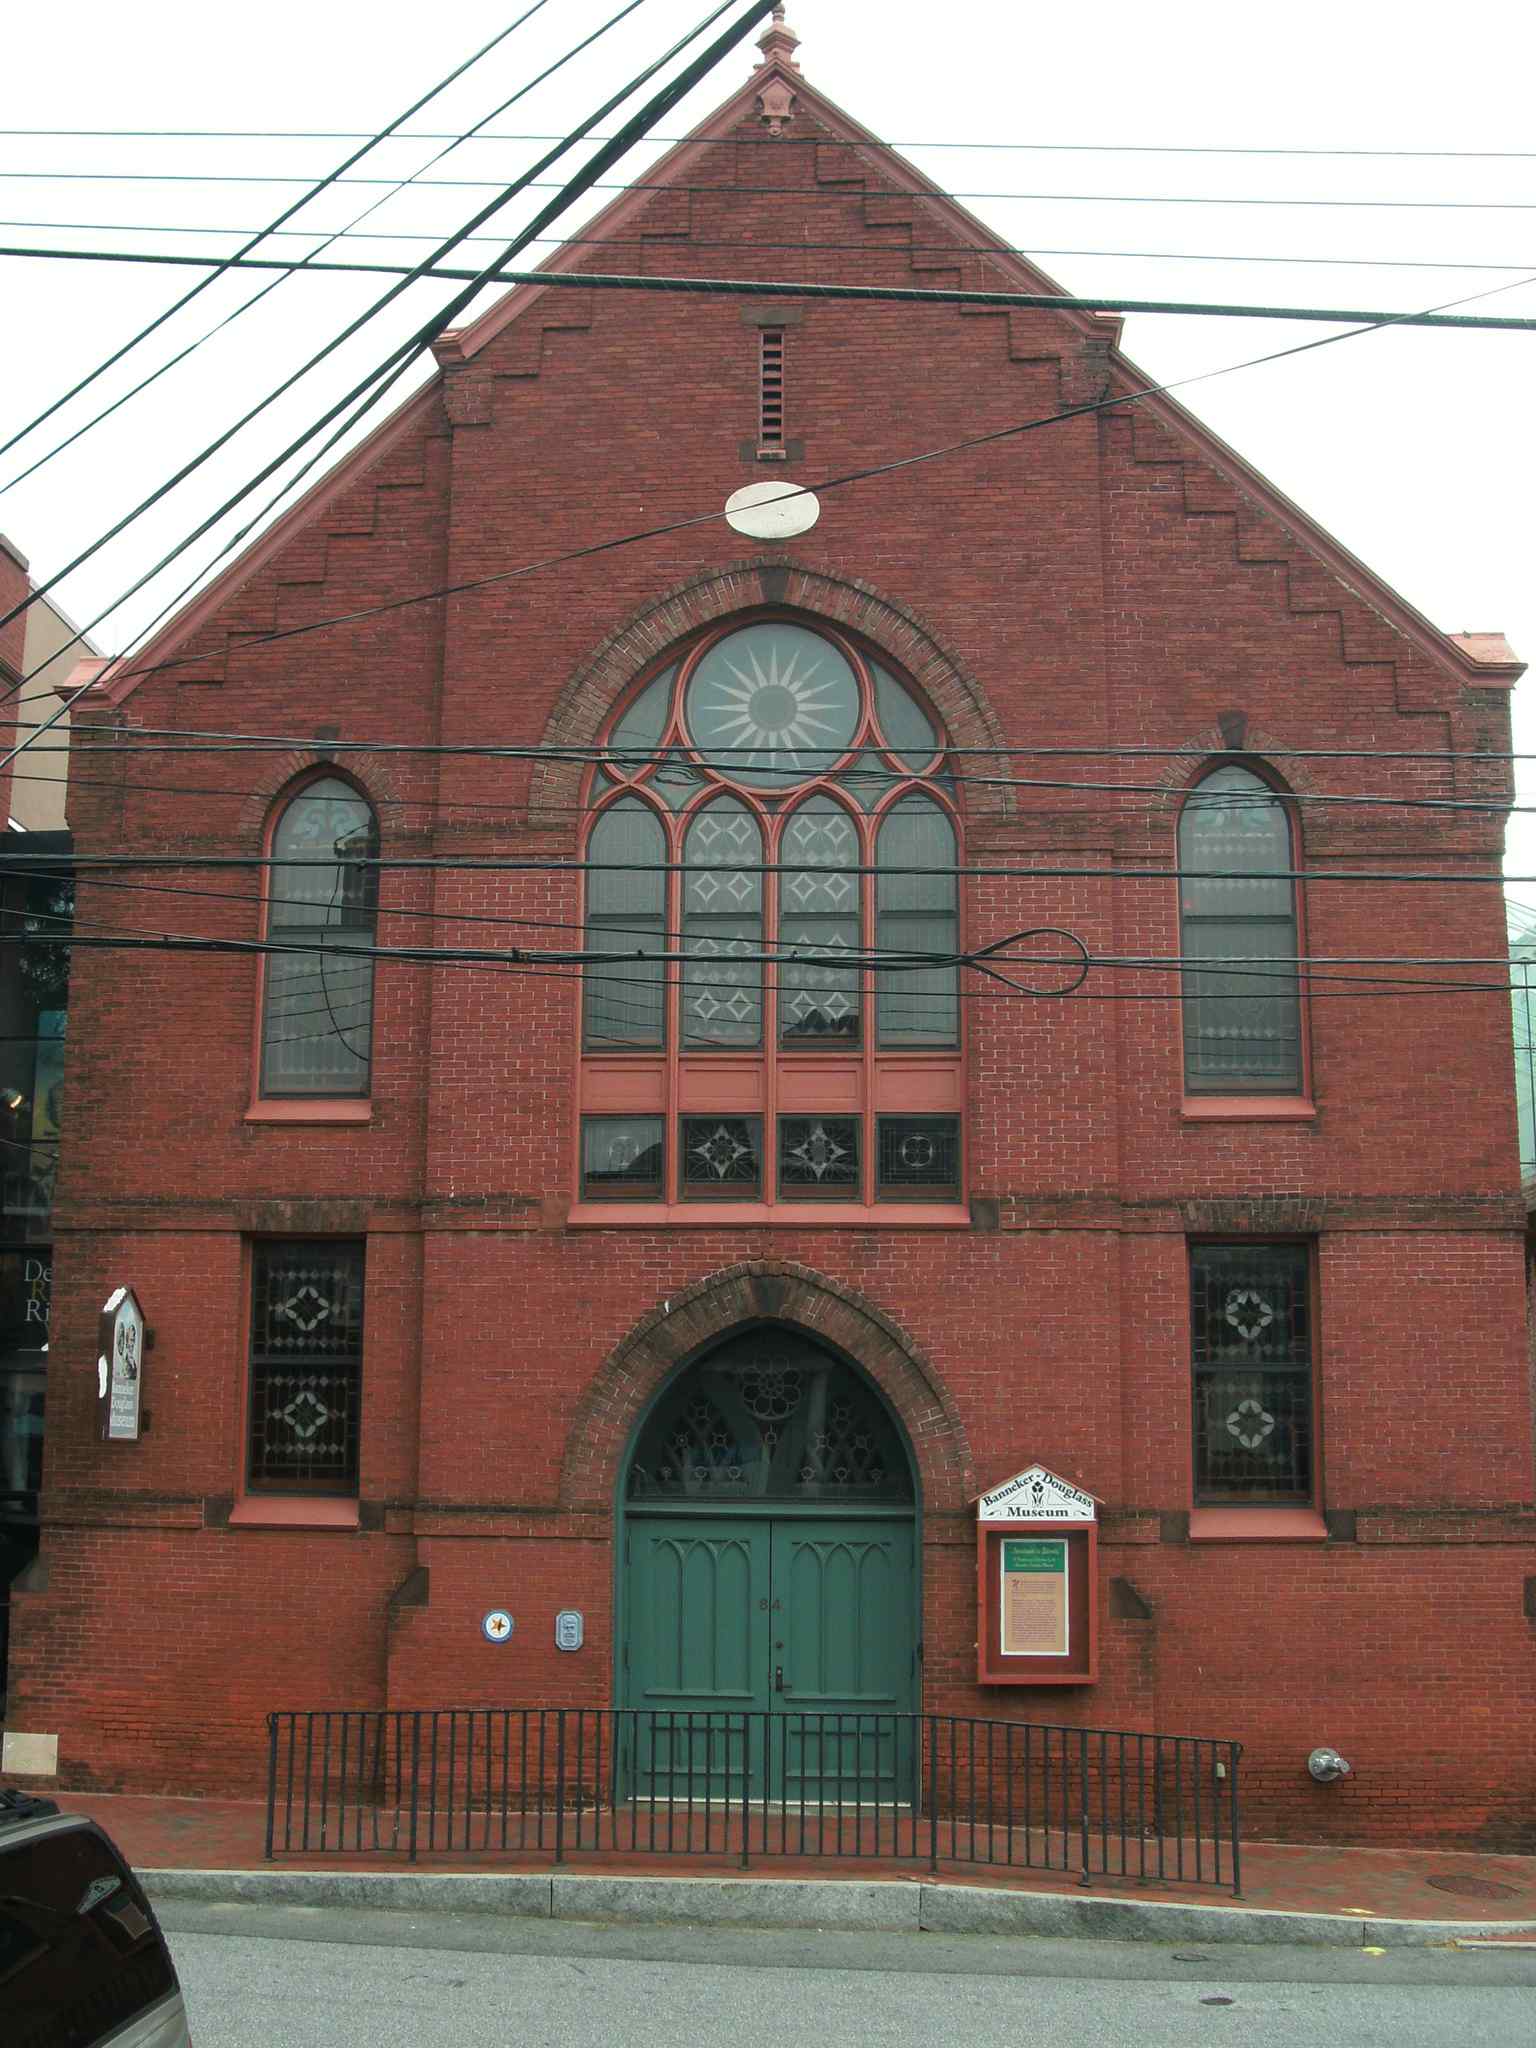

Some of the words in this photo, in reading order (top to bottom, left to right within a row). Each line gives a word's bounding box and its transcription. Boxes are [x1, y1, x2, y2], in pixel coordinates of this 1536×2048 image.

[982, 1474, 1034, 1506] Banneker
[1041, 1472, 1093, 1508] Douglass
[1007, 1506, 1069, 1517] Museum
